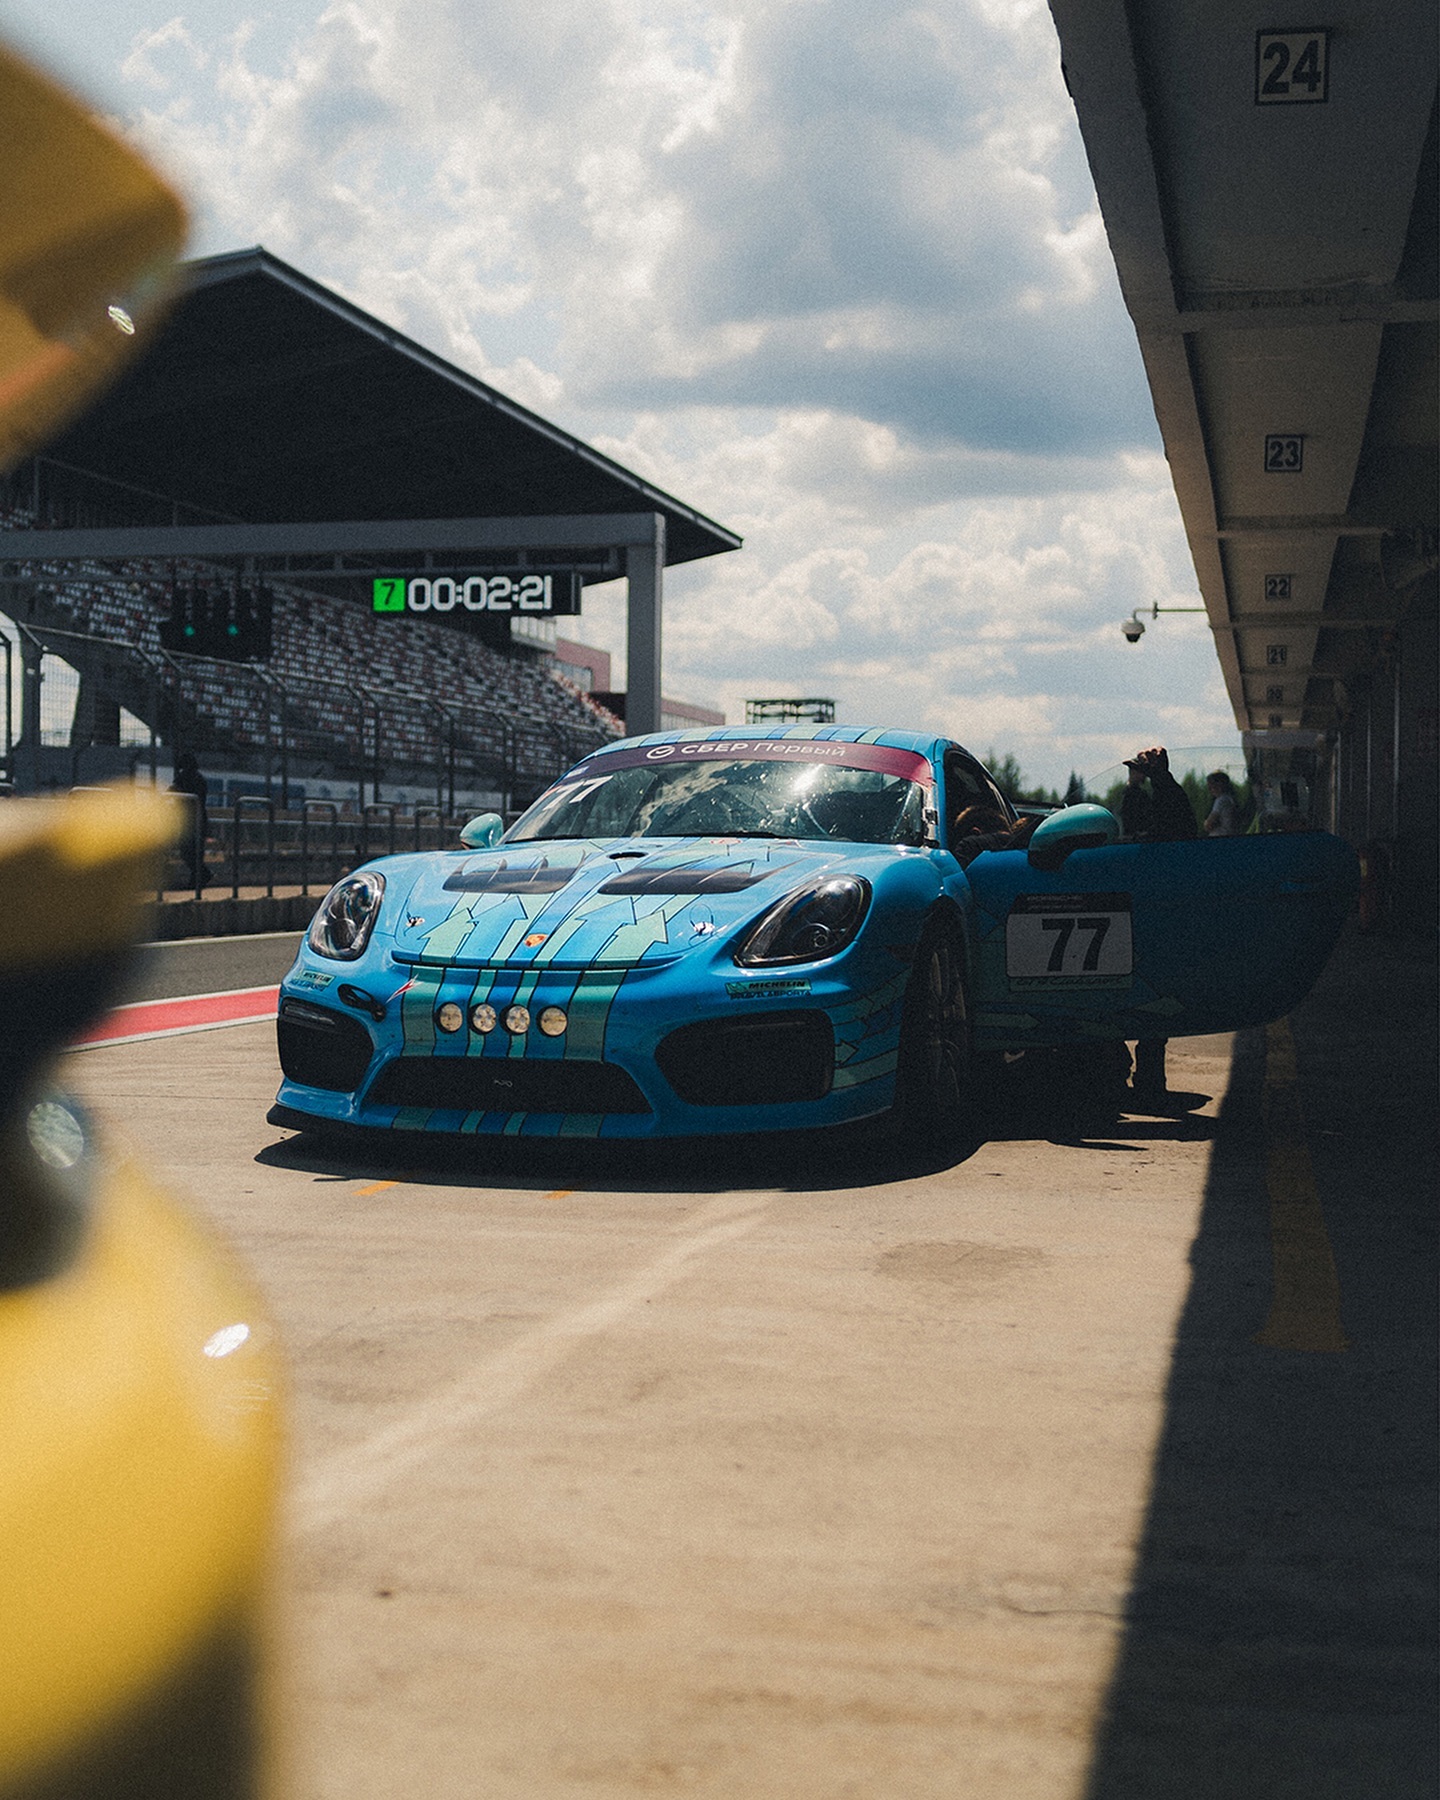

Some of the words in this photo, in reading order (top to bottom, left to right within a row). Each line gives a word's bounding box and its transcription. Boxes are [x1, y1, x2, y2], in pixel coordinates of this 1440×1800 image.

[1262, 40, 1321, 94] 24
[1269, 441, 1299, 467] 23
[381, 582, 396, 606] 7
[408, 575, 553, 612] 00:02:21
[1267, 579, 1289, 596] 22
[1270, 648, 1286, 663] 21
[681, 742, 749, 754] СБЕР
[752, 742, 847, 757] Первый
[542, 775, 613, 811] 77
[1042, 917, 1111, 972] 77
[749, 981, 806, 989] MICHELIN
